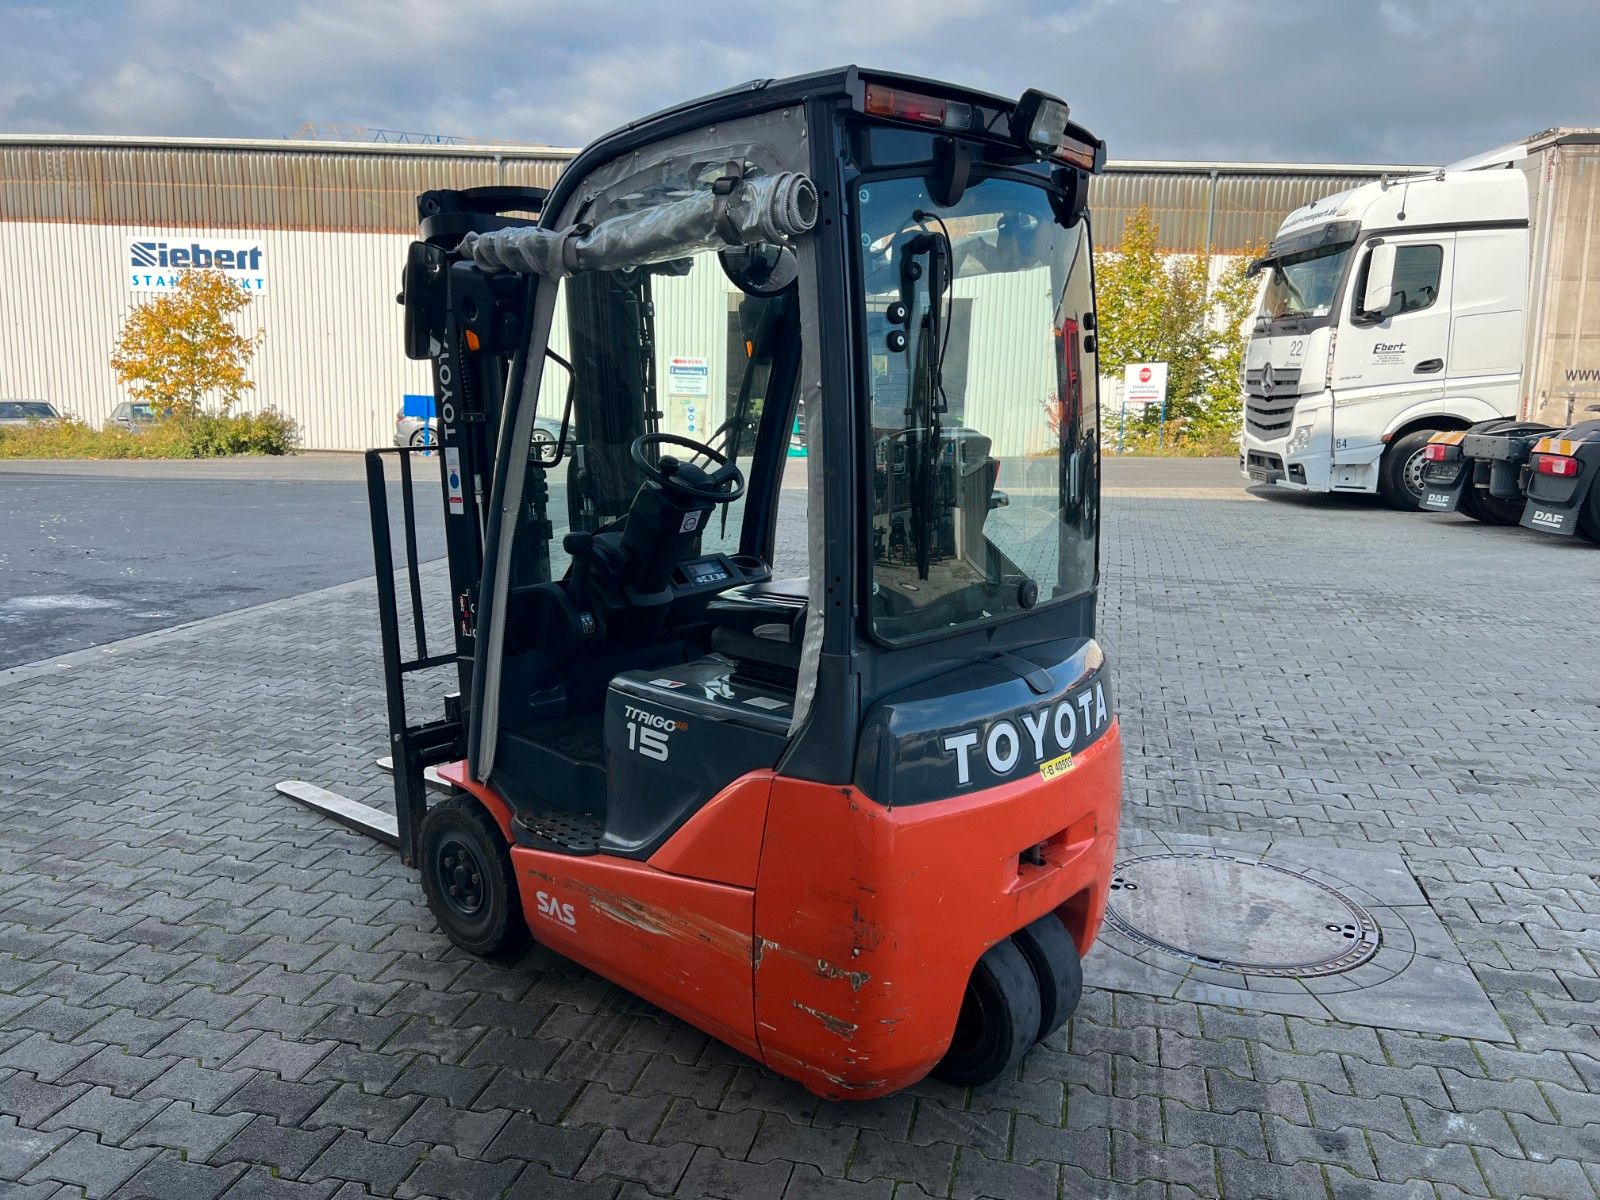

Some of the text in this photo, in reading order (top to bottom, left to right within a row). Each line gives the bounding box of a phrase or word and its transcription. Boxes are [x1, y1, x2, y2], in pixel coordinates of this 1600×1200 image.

[130, 242, 262, 270] Siebert
[133, 275, 263, 289] STAHKT
[1290, 341, 1302, 356] 22
[1372, 342, 1406, 354] Ebert
[1336, 439, 1347, 448] 64
[1428, 494, 1449, 502] DAF
[1533, 510, 1563, 522] DAF
[944, 681, 1107, 785] TOYOTA
[627, 722, 668, 762] 15
[536, 891, 576, 925] SAS
